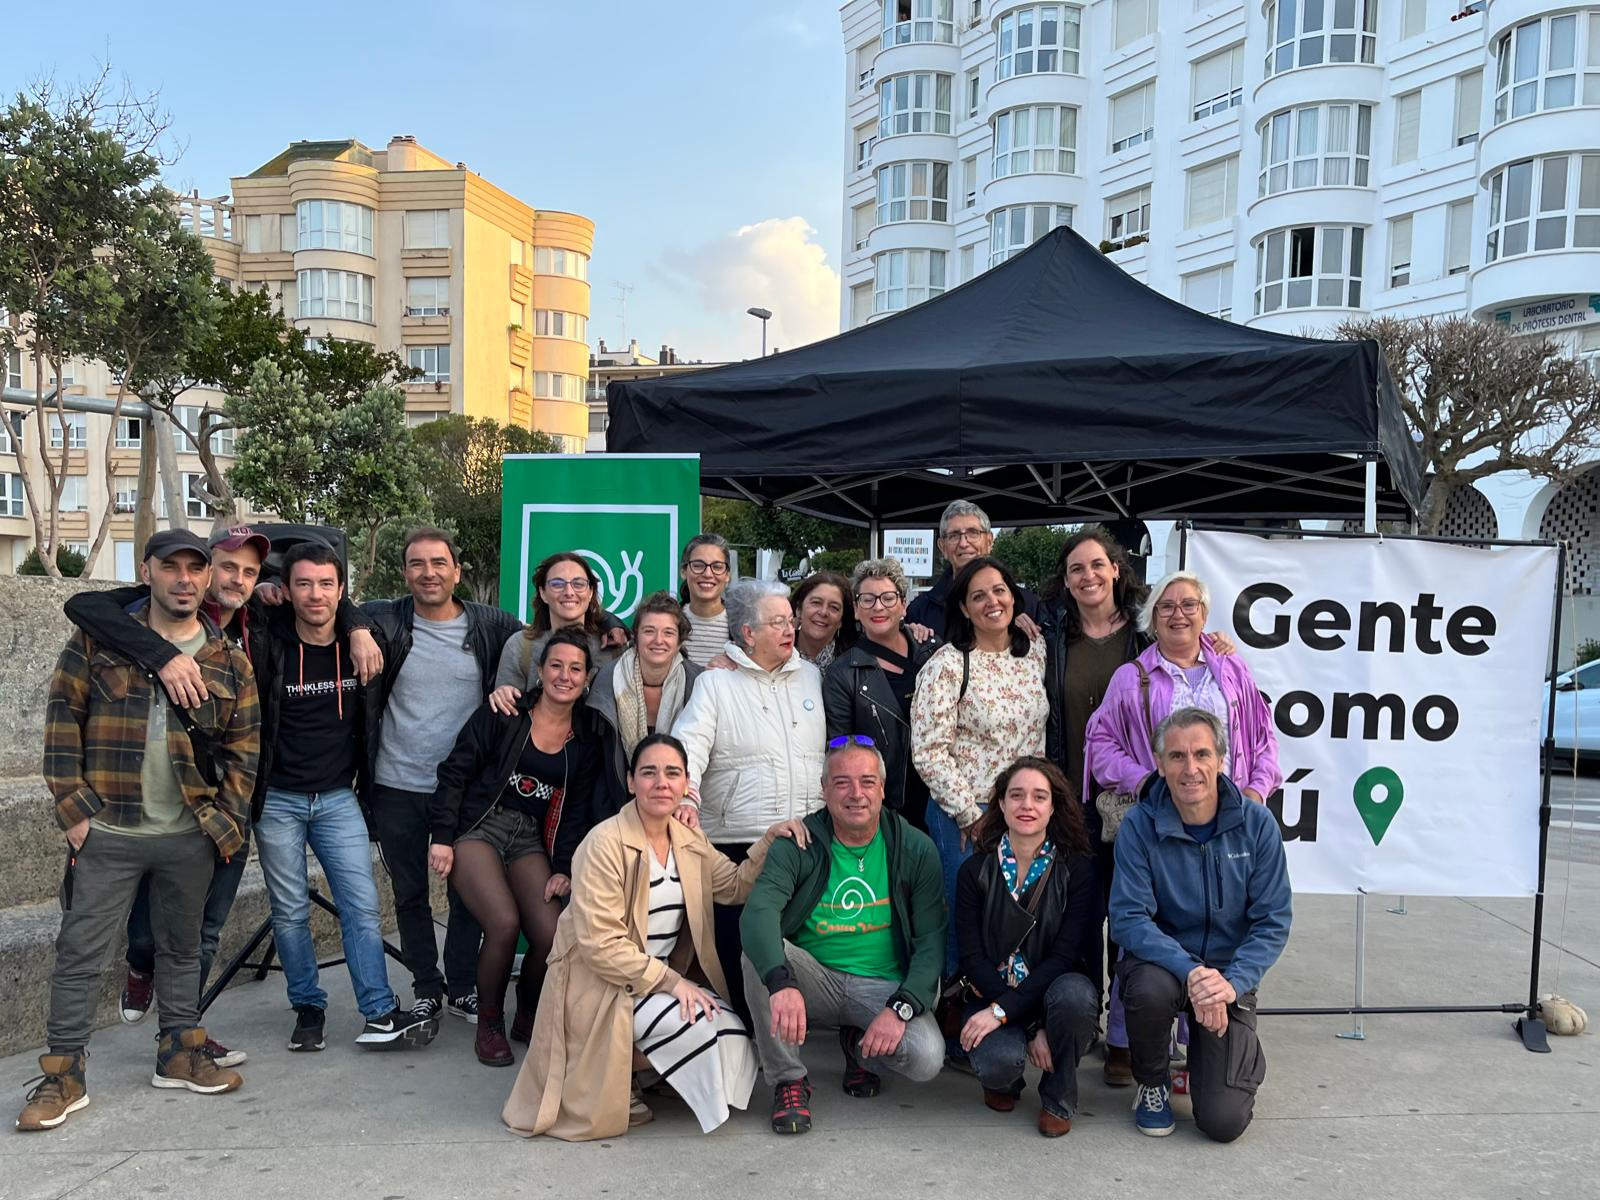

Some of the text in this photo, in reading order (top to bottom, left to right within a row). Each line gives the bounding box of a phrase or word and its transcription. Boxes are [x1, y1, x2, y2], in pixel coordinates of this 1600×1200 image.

[1523, 299, 1576, 317] LABORATORIO
[1511, 323, 1521, 333] DE
[1558, 311, 1587, 325] DENTAL
[1232, 582, 1497, 656] Gente
[286, 681, 335, 693] THINKLESS
[1260, 689, 1459, 742] omo
